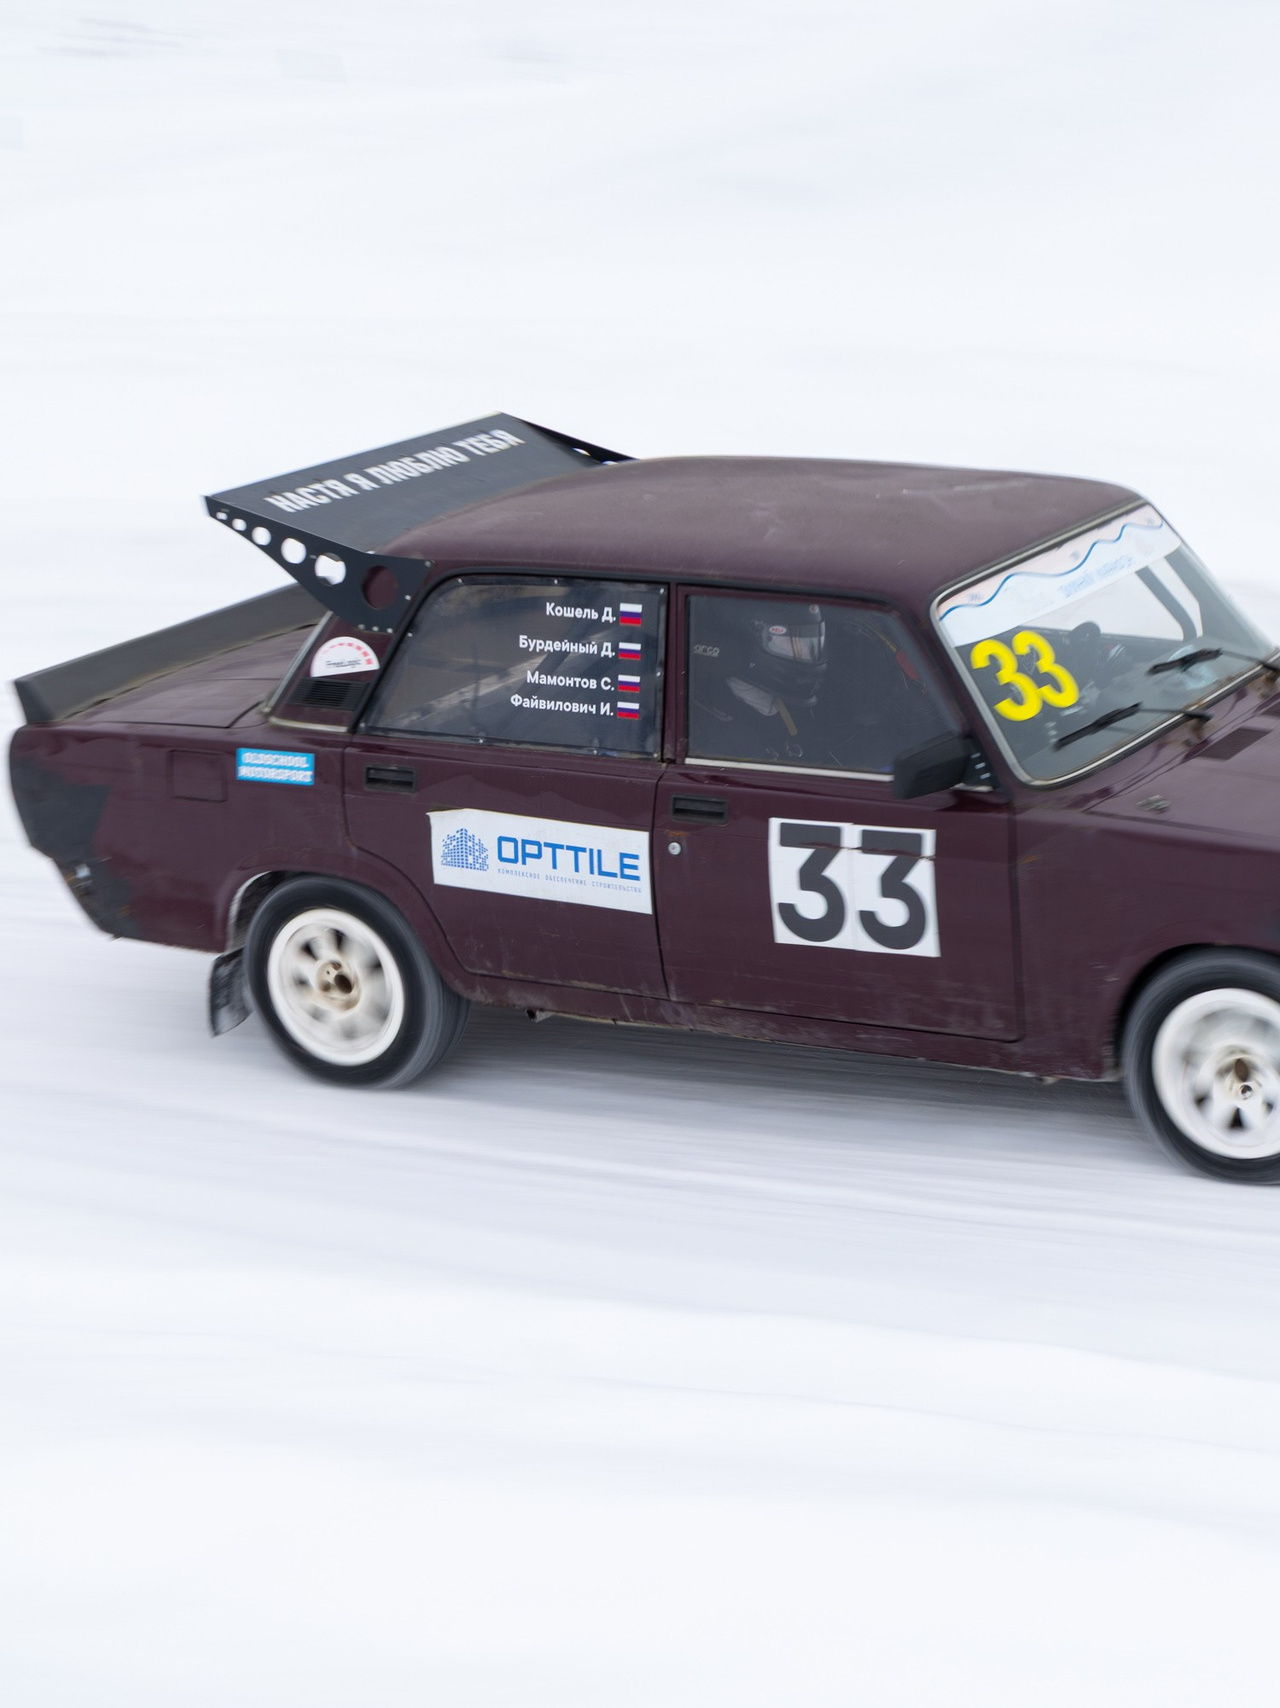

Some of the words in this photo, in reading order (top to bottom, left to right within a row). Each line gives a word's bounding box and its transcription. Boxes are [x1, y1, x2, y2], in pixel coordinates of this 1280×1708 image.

[263, 479, 360, 513] НАСТЯ
[343, 472, 381, 491] Я
[363, 446, 471, 485] ЛЮБЛЮ
[451, 428, 526, 456] ТЕБЯ
[545, 602, 599, 620] Кошель
[601, 606, 617, 623] Д.
[519, 634, 598, 655] Бурдейный
[600, 642, 616, 658] Д.
[526, 670, 598, 690] Мамонтов
[600, 677, 615, 691] С.
[971, 631, 1078, 721] 33
[510, 693, 597, 715] Файвилович
[600, 701, 614, 716] И.
[497, 835, 641, 881] OPTTILE
[777, 822, 927, 950] 33
